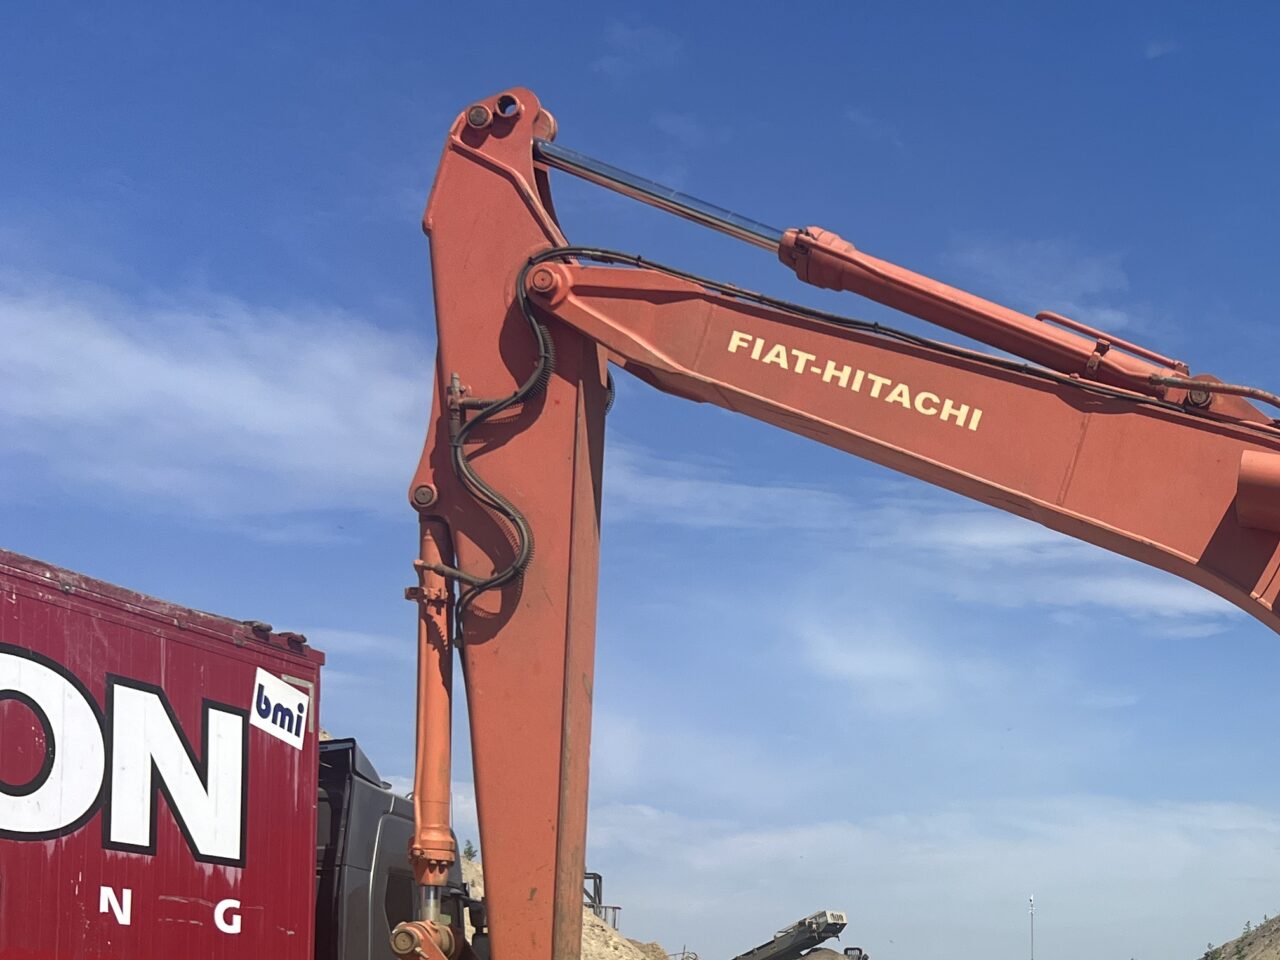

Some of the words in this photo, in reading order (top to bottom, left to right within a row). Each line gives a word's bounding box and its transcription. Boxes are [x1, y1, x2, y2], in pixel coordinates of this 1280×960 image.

[727, 330, 983, 432] FIAT-HITACHI
[255, 683, 305, 738] bmi
[99, 885, 132, 926] N
[213, 898, 242, 934] G
